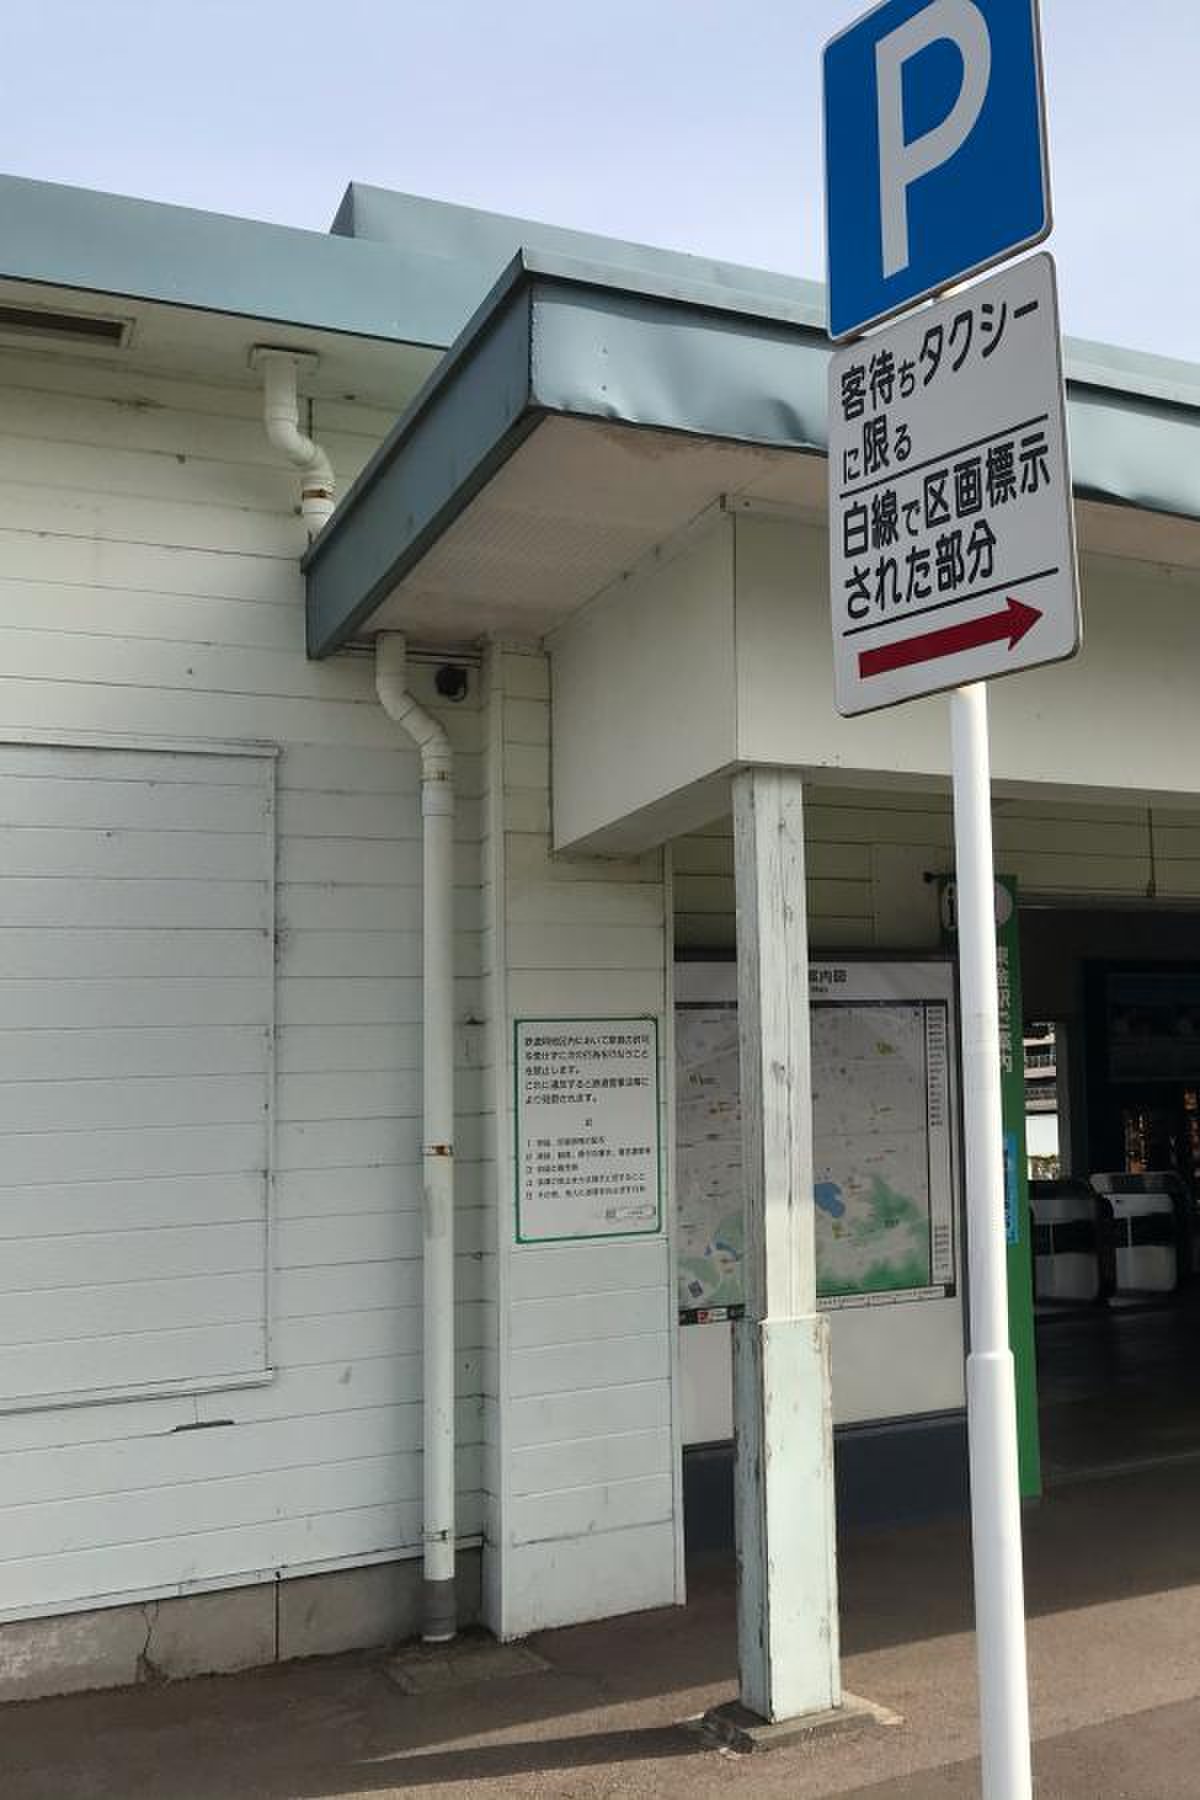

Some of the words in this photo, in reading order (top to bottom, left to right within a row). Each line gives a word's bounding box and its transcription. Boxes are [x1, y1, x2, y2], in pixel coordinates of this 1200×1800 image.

[875, 0, 992, 279] P
[840, 301, 1040, 420] 客待ちタクシー
[843, 417, 914, 483] に限る
[843, 430, 1050, 558] 白線で区画標示
[844, 519, 999, 618] された部分
